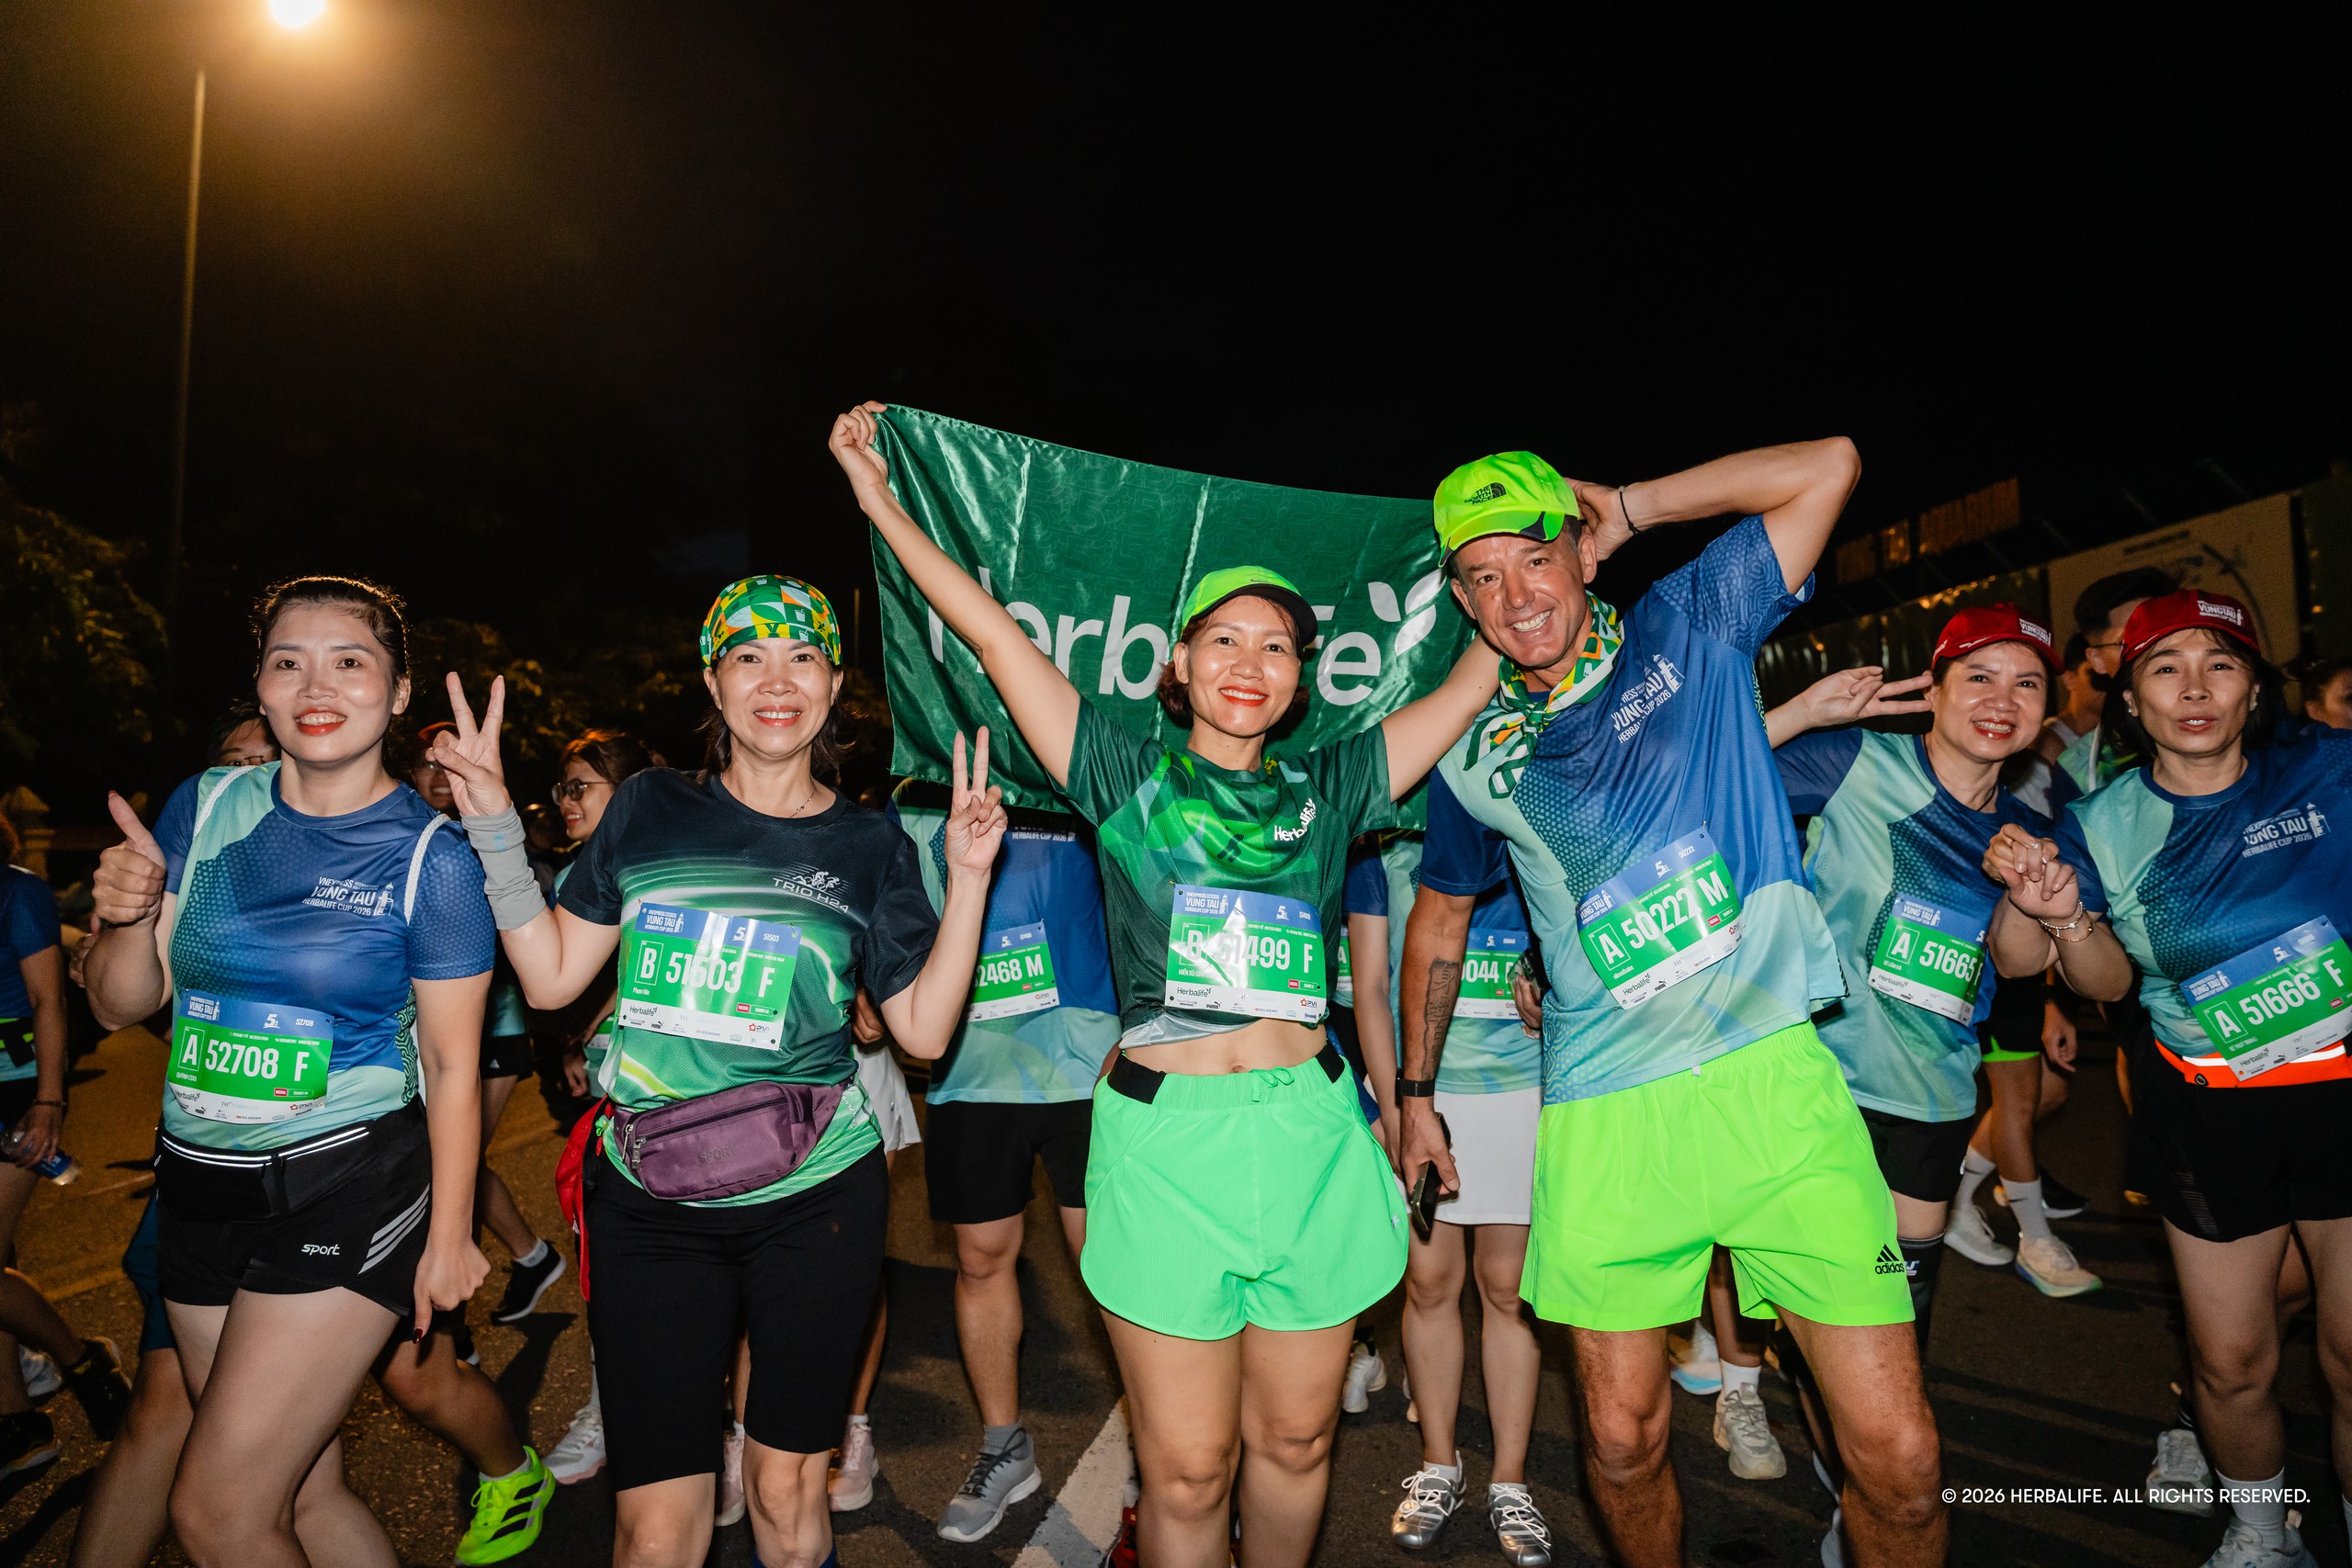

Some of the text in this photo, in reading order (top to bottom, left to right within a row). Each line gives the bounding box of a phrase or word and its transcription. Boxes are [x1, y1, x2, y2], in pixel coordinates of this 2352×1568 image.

[1464, 491, 1491, 503] NORTH
[1476, 485, 1490, 495] THE
[1655, 689, 1672, 706] 2026
[2278, 817, 2308, 835] TAU
[2243, 832, 2312, 858] HERBALIFE CUP 2026
[349, 891, 376, 906] TAU
[773, 878, 849, 913] TRIO H24
[1186, 897, 1219, 908] VUNG TAU
[302, 898, 371, 916] HERBALIFE CUP 2026
[1591, 898, 1605, 910] TAU
[1598, 932, 1624, 964] A
[1621, 887, 1702, 949] 50222
[1697, 871, 1729, 907] M
[1904, 905, 1933, 920] VUNG TAU
[647, 915, 675, 927] VUNG TAU
[763, 933, 779, 942] 51503
[1187, 930, 1313, 973] B 51499 F
[1891, 932, 1911, 959] A
[1919, 941, 1977, 982] 51665
[640, 948, 775, 998] B 51503 F
[975, 953, 1044, 987] 2468 M
[1623, 977, 1650, 996] Herbalife
[1879, 974, 1905, 988] Herbalife
[1177, 987, 1208, 998] Herbalife
[2214, 959, 2344, 1038] A 51666 F
[189, 1001, 213, 1014] VUNG TAU
[630, 1006, 654, 1016] Herbalife
[296, 1019, 314, 1027] 52708
[182, 1034, 310, 1082] A 52708 F
[175, 1089, 198, 1101] Herbalife
[301, 1244, 340, 1256] sport
[1874, 1262, 1905, 1275] adidas
